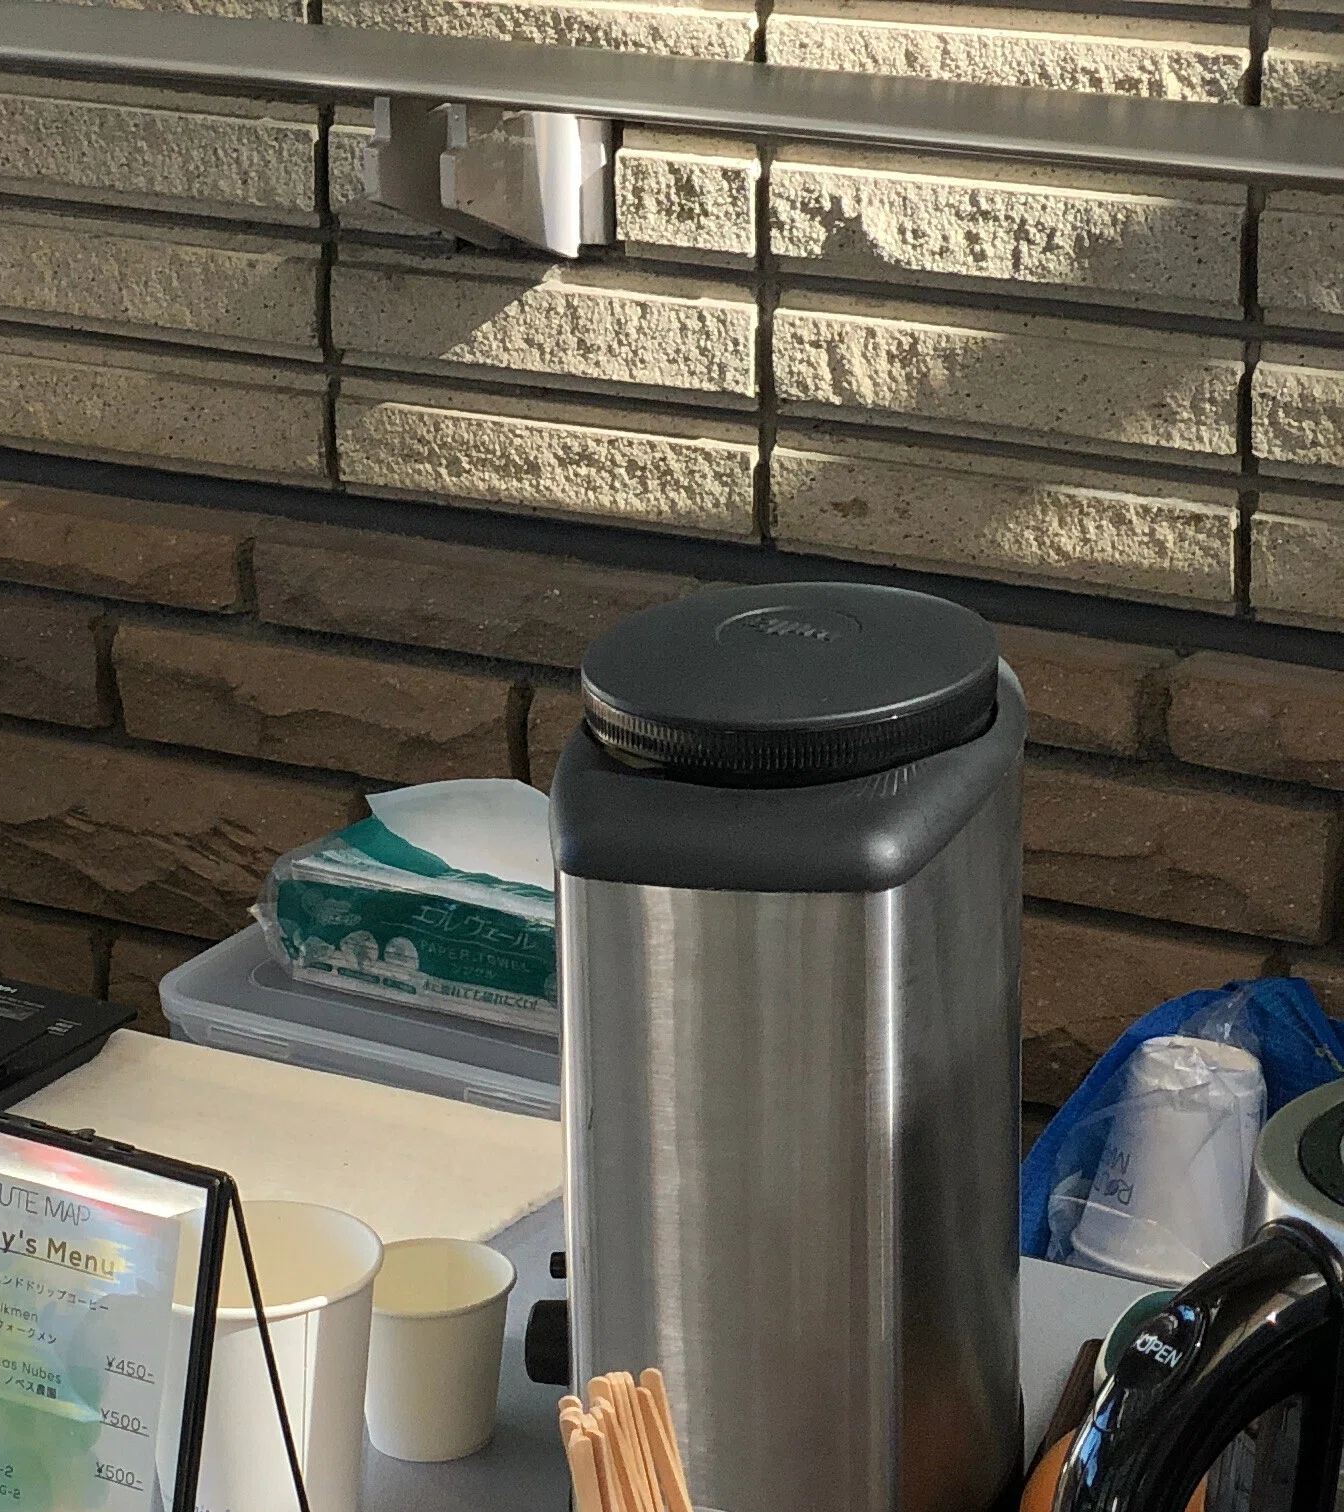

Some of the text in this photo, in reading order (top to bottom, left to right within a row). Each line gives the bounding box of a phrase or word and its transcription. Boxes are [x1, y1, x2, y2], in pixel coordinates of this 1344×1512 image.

[412, 903, 536, 949] エルヴェール
[421, 940, 475, 963] PAPER
[44, 1196, 91, 1226] MAP
[47, 1238, 115, 1277] Menu
[1135, 1333, 1183, 1368] OPEN
[22, 1362, 61, 1384] Nubes
[105, 1354, 155, 1384] ¥450-
[100, 1407, 149, 1437] ¥500-
[94, 1461, 144, 1491] ¥500-
